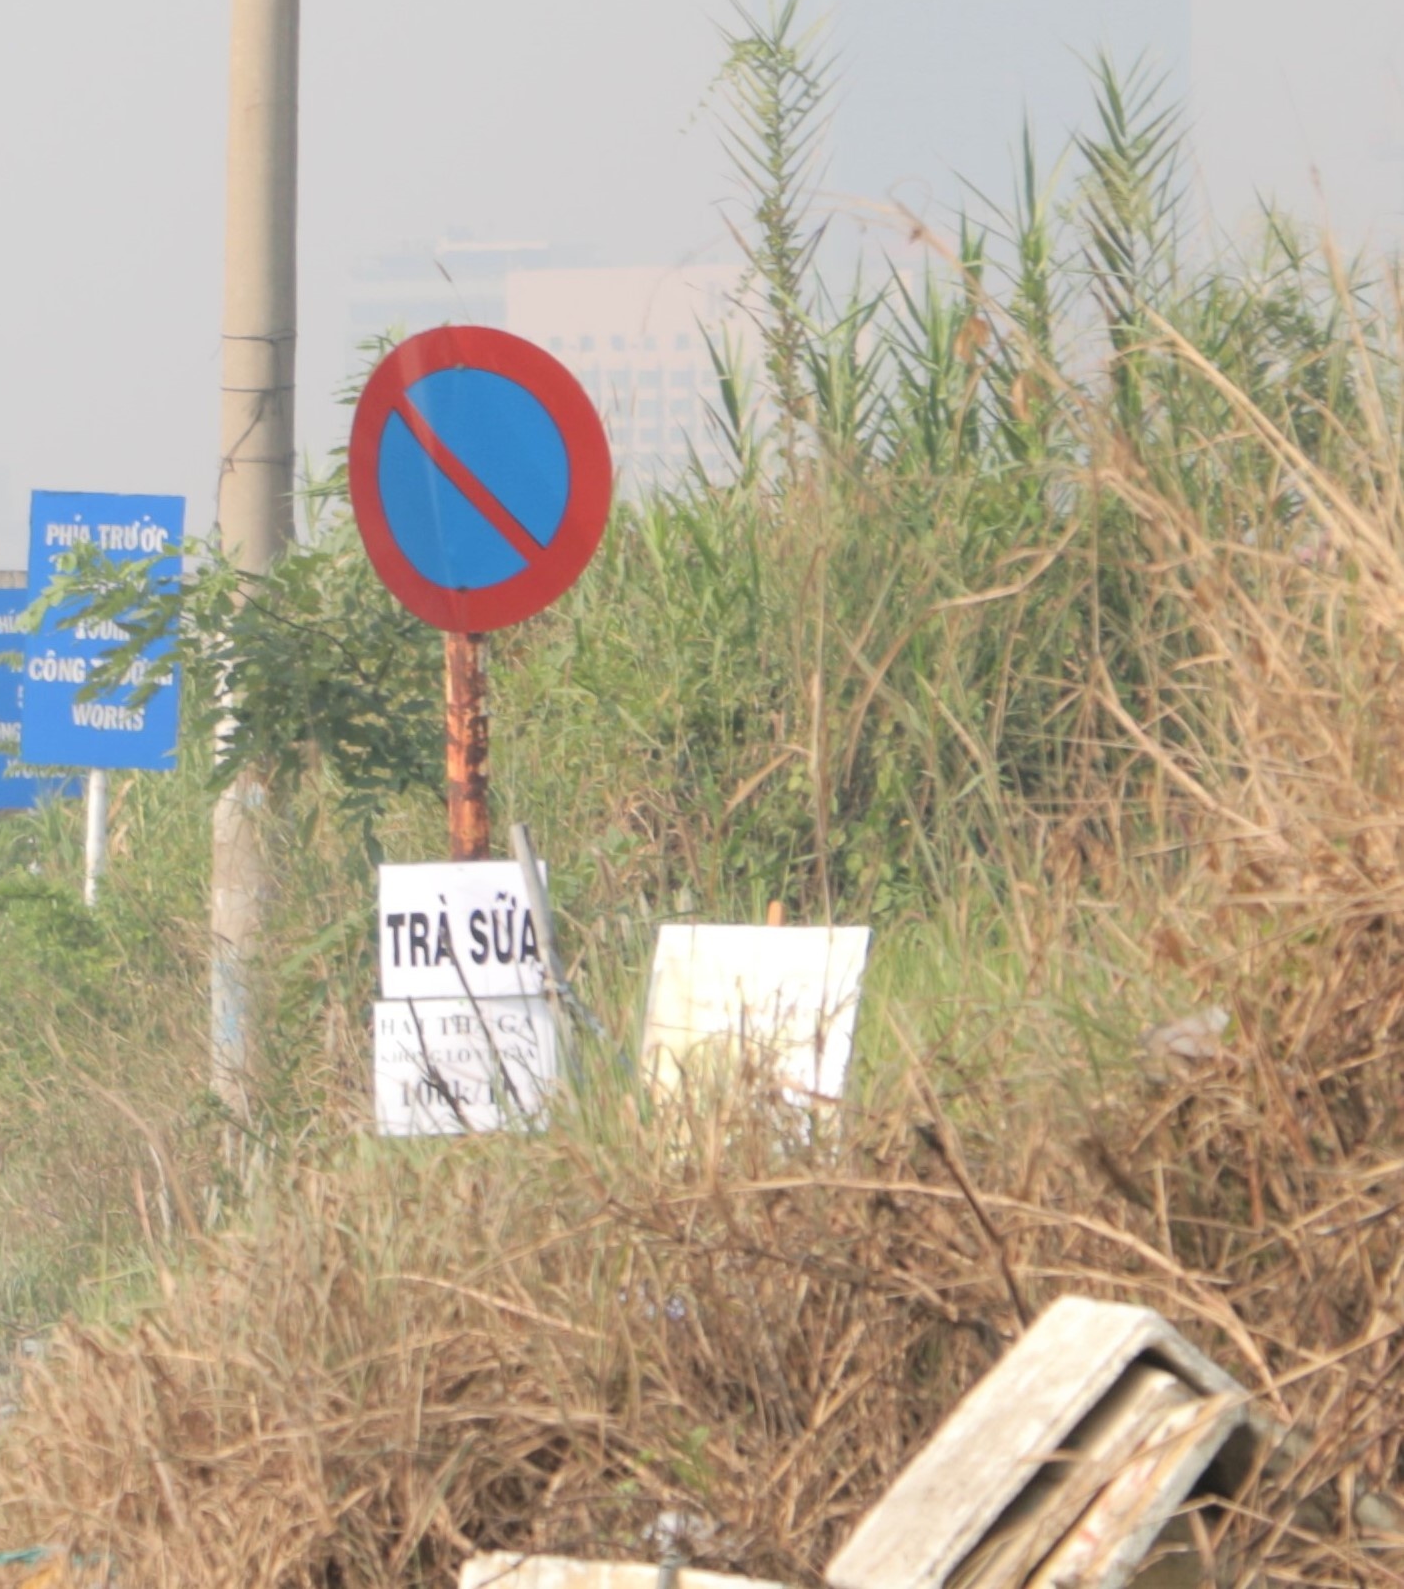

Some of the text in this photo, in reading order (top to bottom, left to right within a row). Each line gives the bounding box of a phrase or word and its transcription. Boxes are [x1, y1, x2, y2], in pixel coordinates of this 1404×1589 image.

[28, 648, 86, 683] CÔNG
[387, 889, 542, 967] TRÀ SỮA
